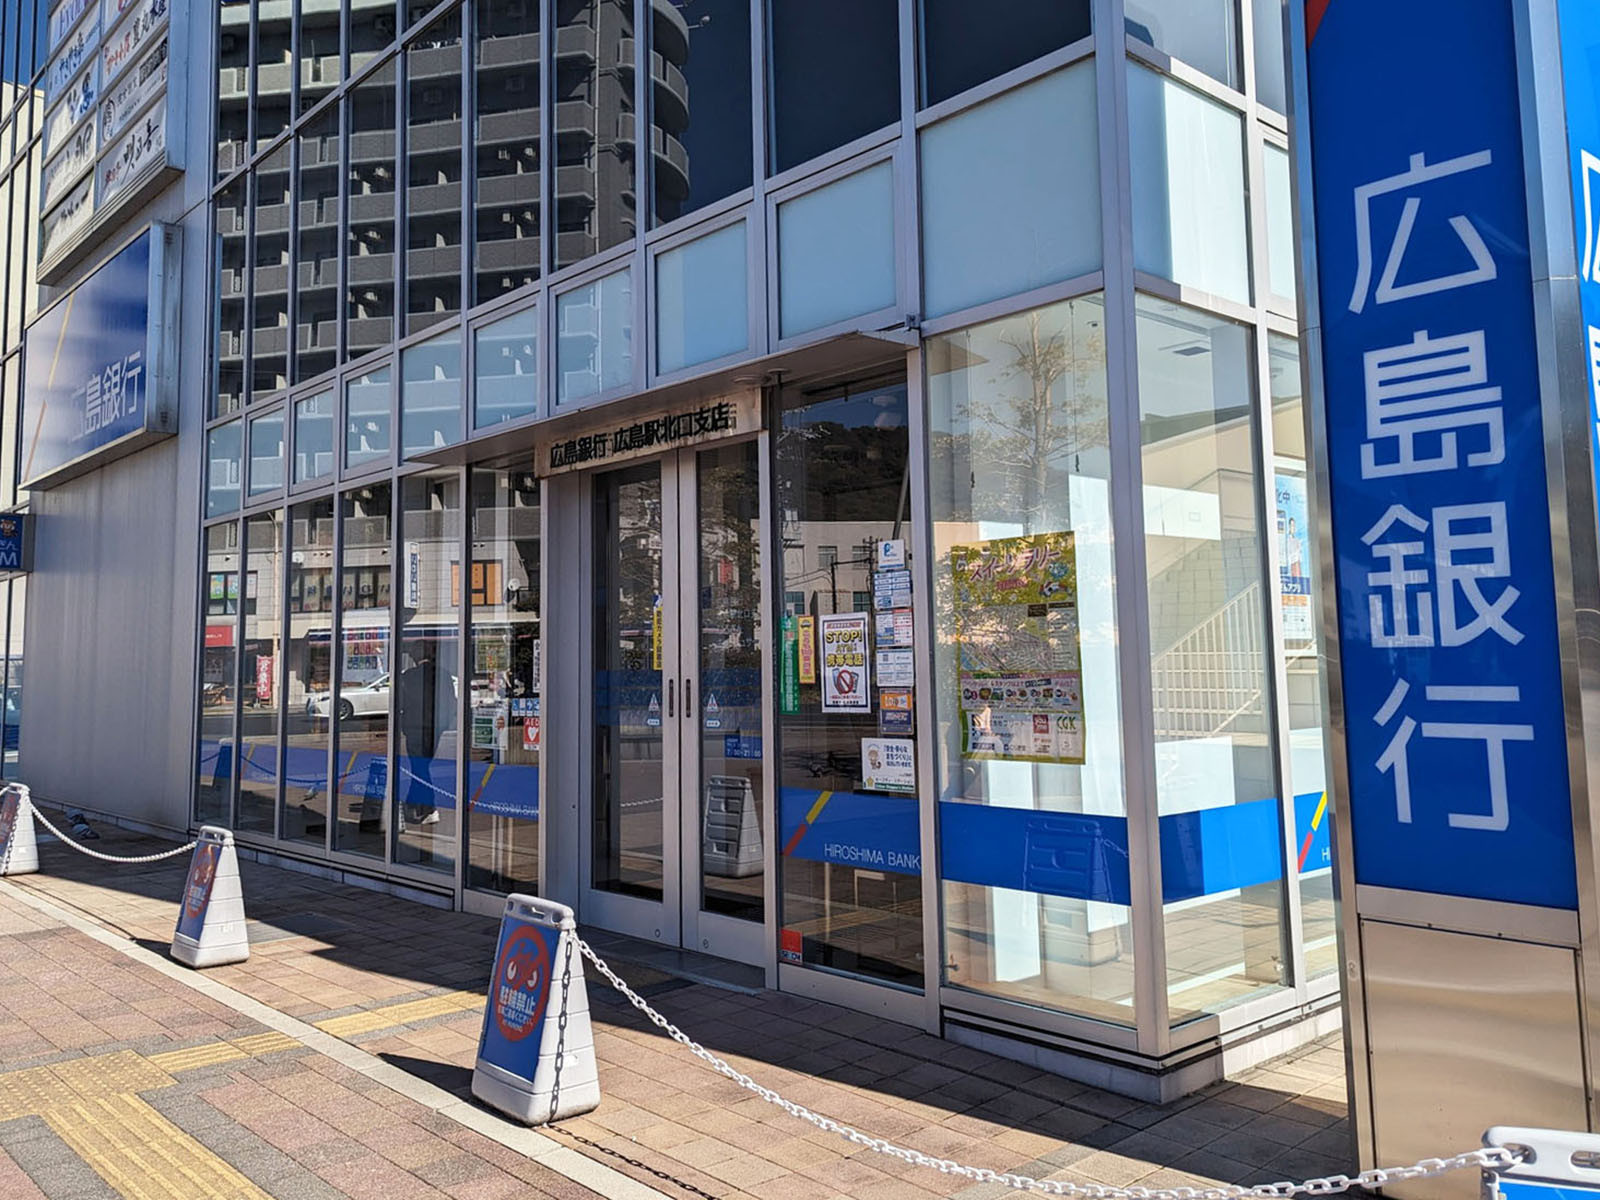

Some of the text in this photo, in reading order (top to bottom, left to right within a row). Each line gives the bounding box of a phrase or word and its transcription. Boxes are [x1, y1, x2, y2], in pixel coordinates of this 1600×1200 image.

[550, 401, 731, 468] 広島銀行 広島駅北口支店
[1348, 148, 1535, 832] 広島銀行
[826, 630, 863, 644] STOP!
[824, 843, 921, 869] HIROSHIMA BANK
